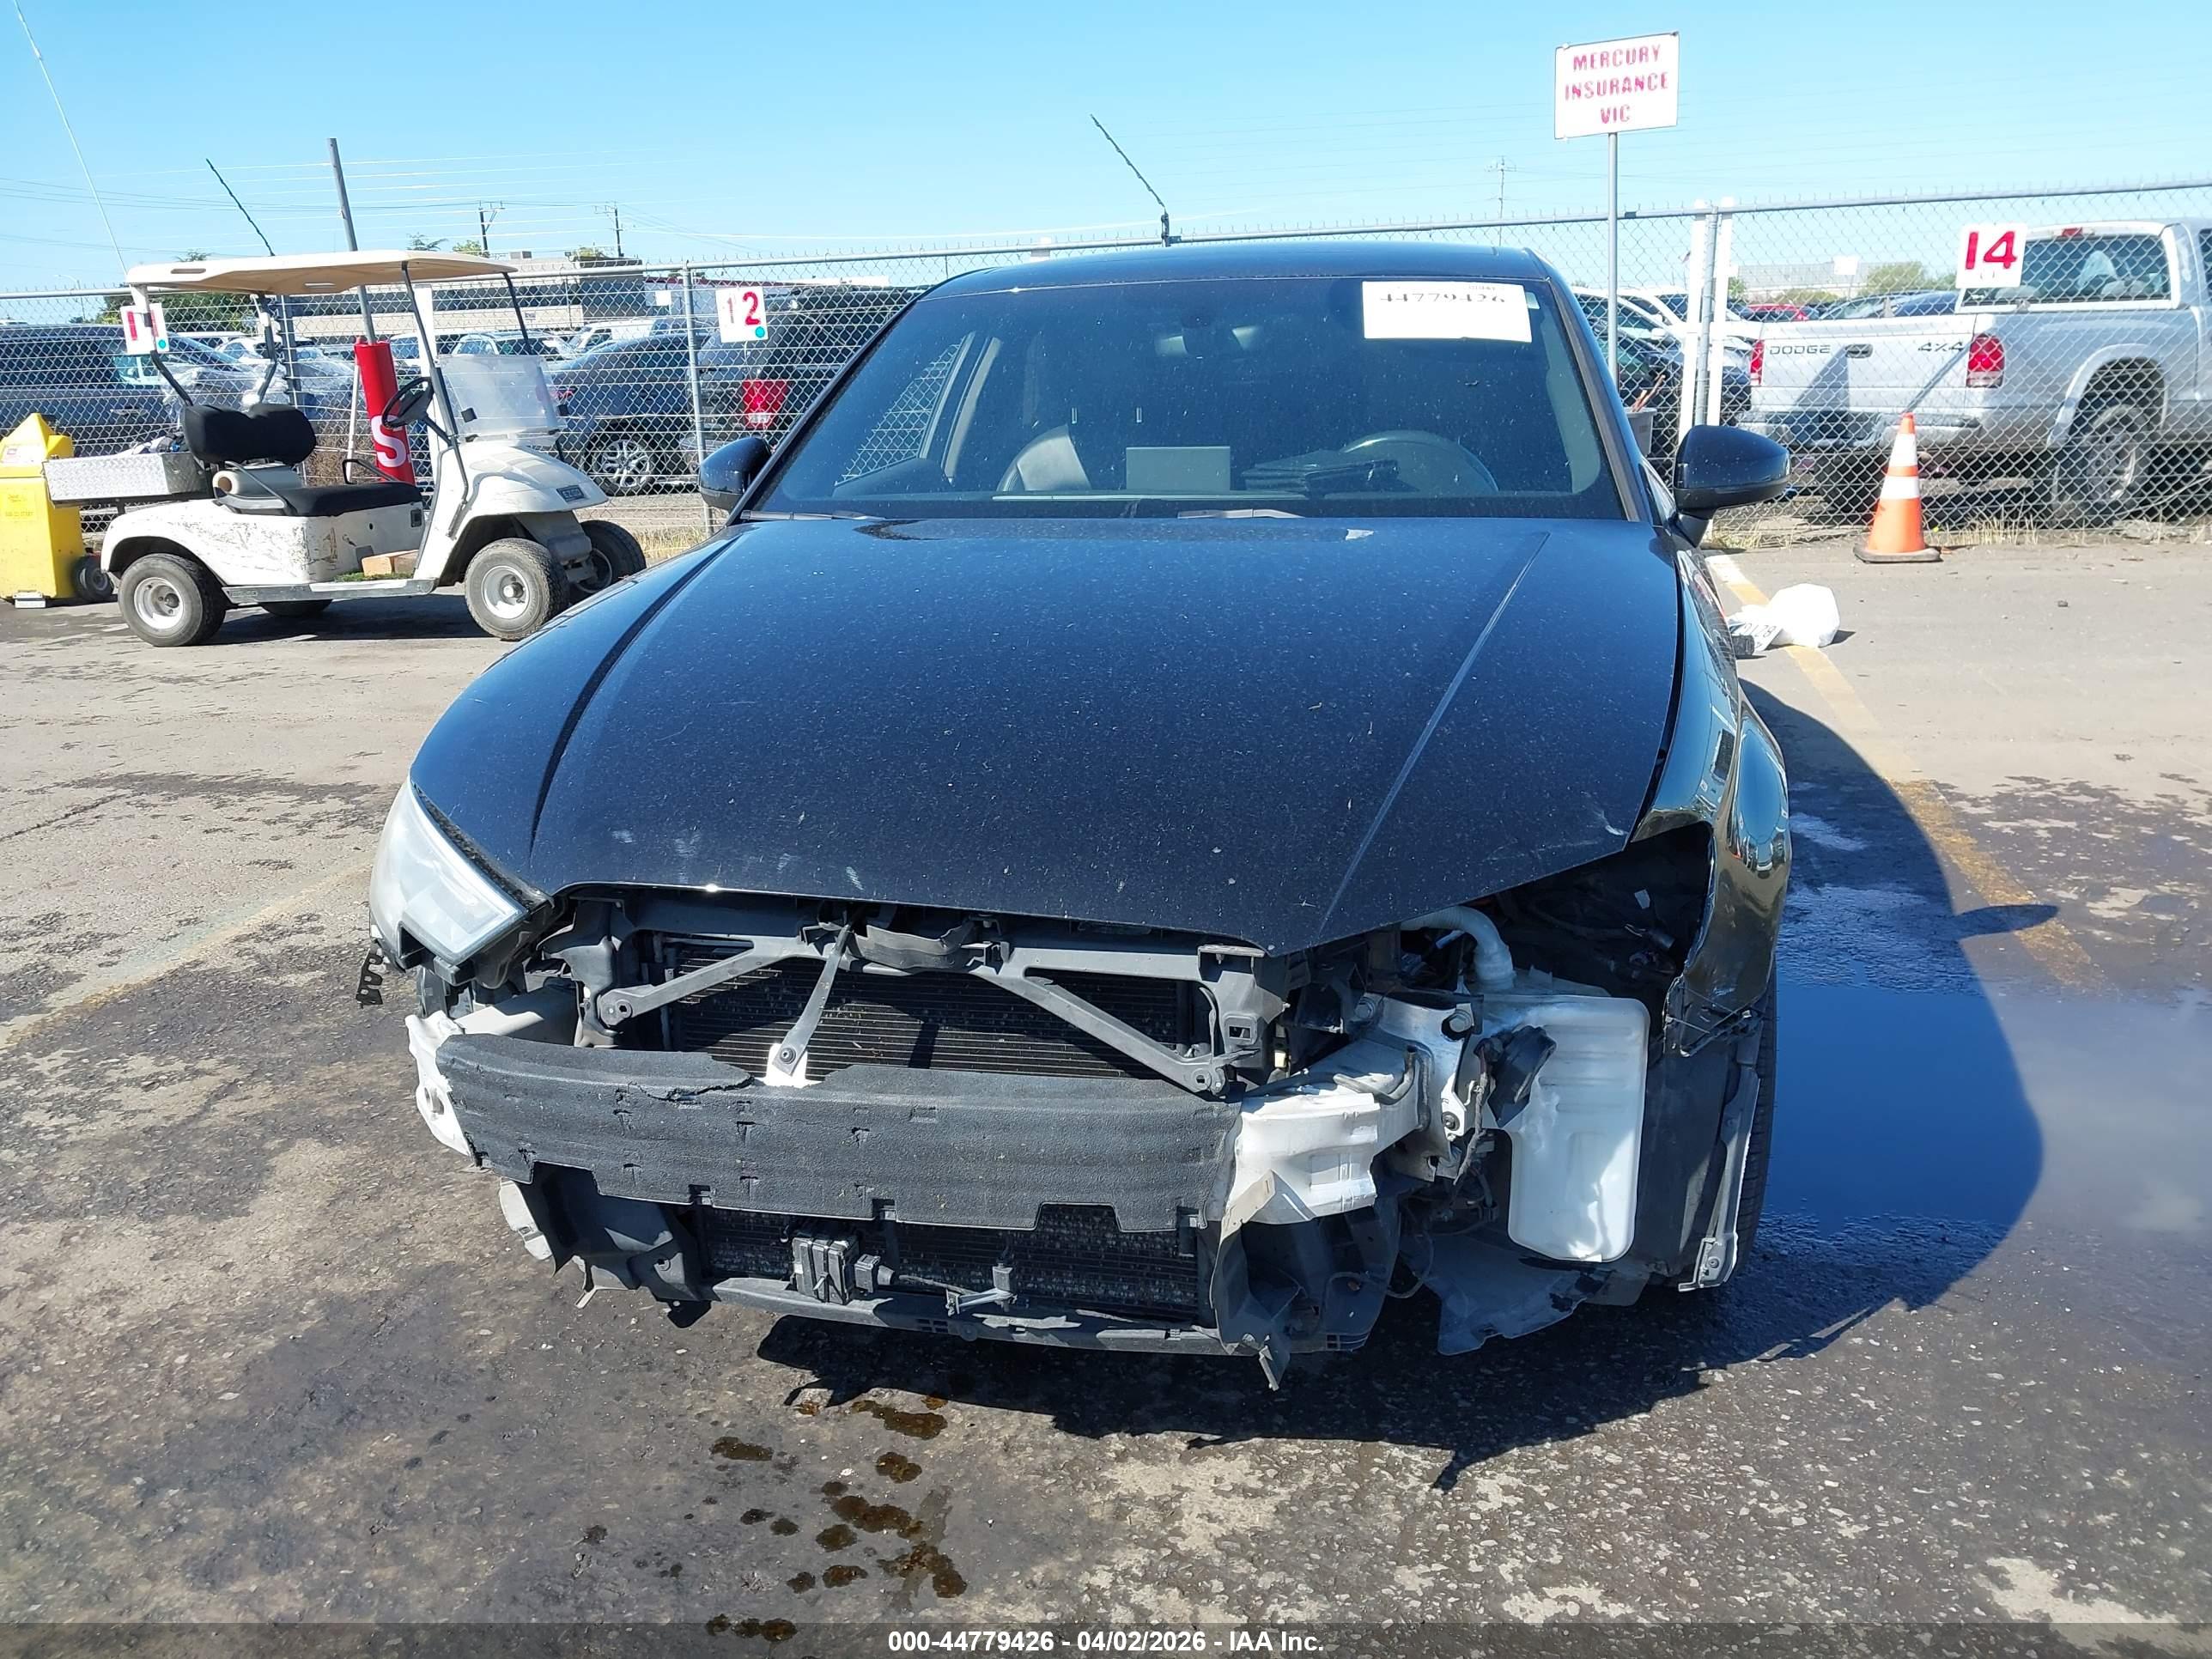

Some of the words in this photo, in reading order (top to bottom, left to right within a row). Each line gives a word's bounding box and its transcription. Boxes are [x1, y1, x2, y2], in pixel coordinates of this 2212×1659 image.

[1573, 44, 1661, 72] MERCURY
[1565, 72, 1668, 100] INSURANCE
[1601, 104, 1631, 124] VIC
[1965, 231, 2017, 270] 14
[726, 291, 761, 325] 12
[1769, 344, 1832, 355] DODGE
